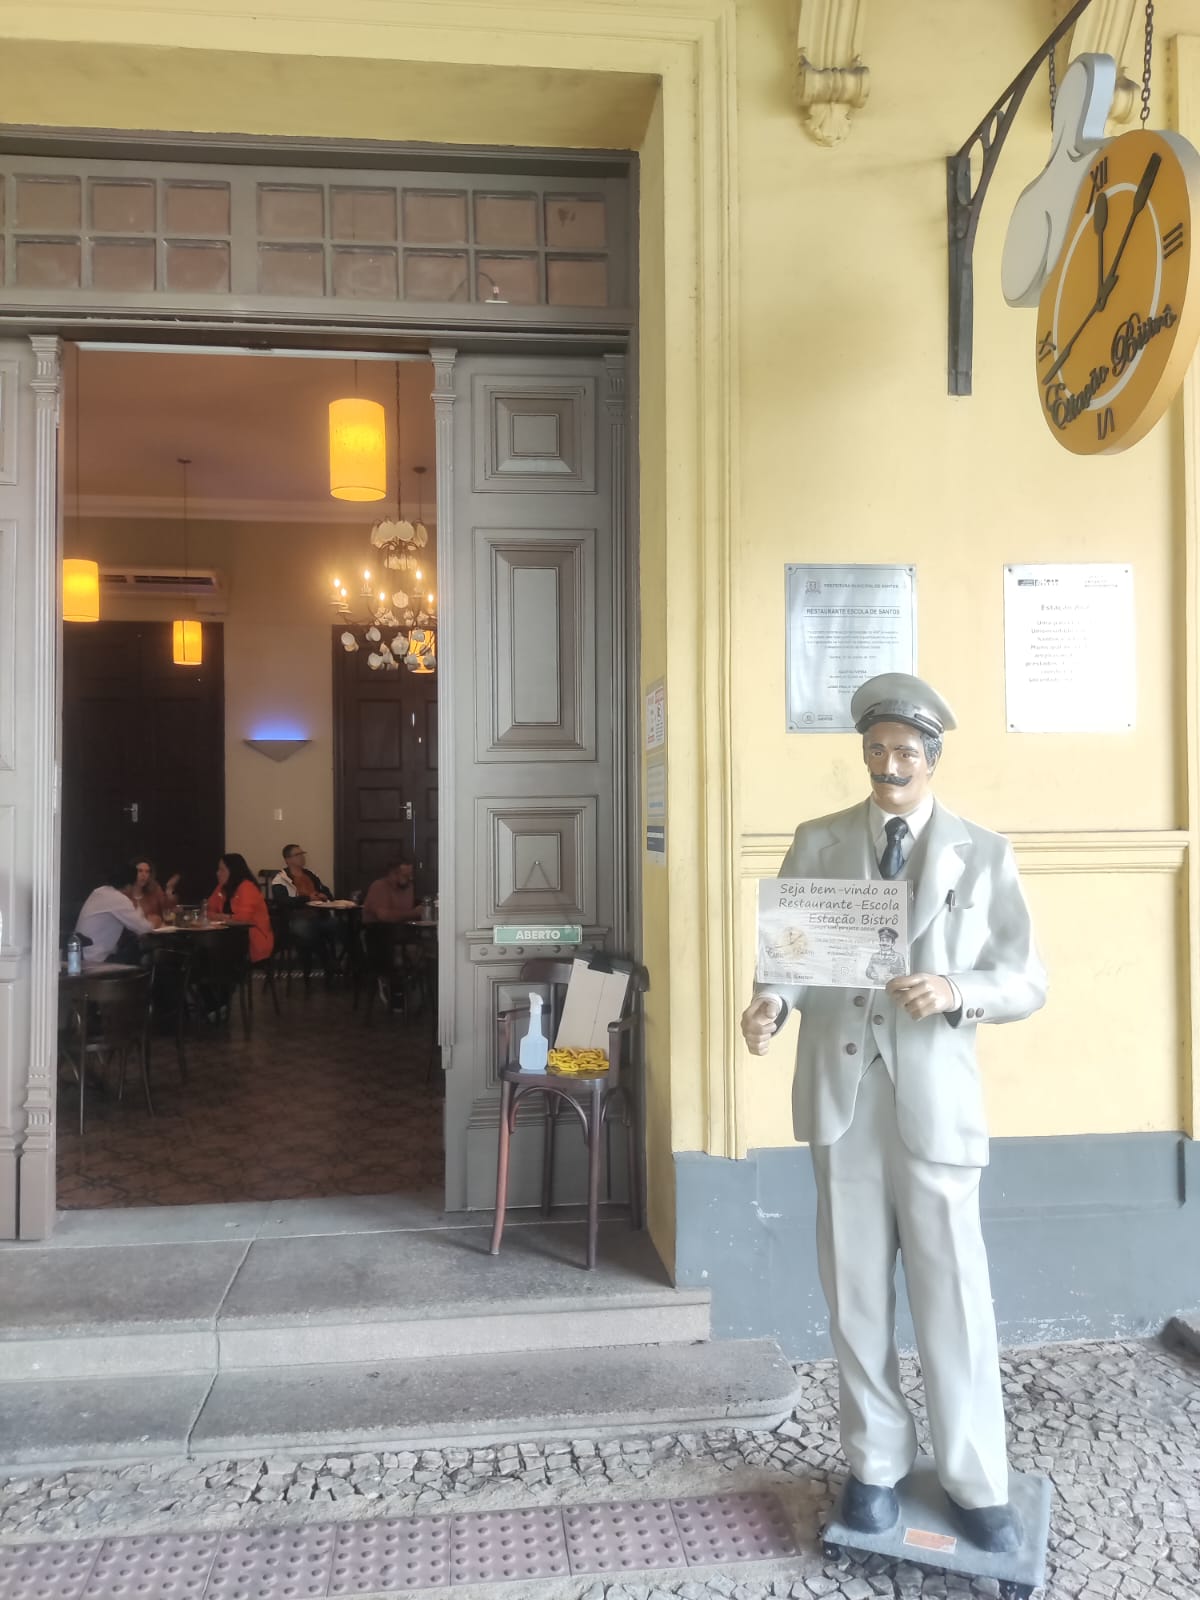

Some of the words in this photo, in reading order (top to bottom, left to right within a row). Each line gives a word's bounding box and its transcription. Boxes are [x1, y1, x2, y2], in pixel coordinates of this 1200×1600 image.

[1110, 303, 1178, 377] Bistrô
[806, 607, 846, 615] RESTAURANTE
[780, 883, 805, 898] Seja
[810, 882, 878, 895] bem-vindo
[883, 887, 898, 895] ao
[778, 898, 899, 911] Restaurante-Escola
[808, 912, 856, 927] Estação
[861, 913, 899, 925] Bistrô
[515, 929, 561, 940] ABERTO
